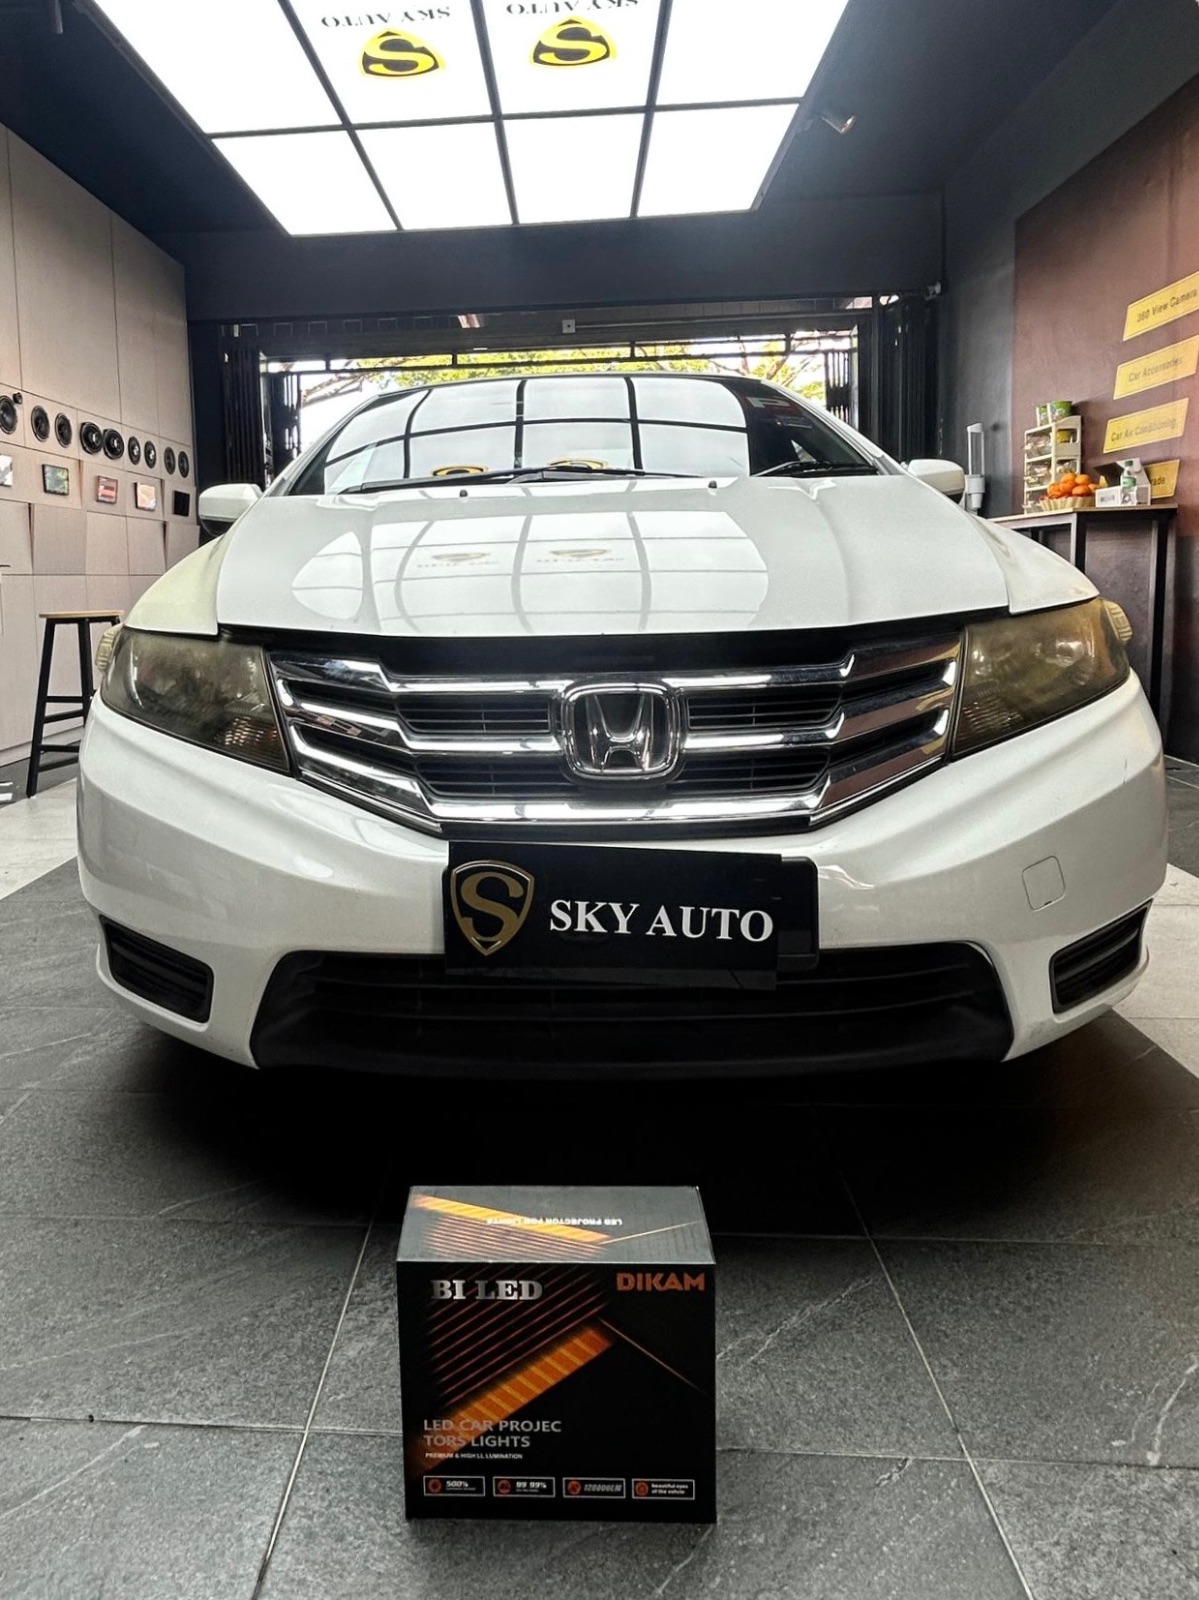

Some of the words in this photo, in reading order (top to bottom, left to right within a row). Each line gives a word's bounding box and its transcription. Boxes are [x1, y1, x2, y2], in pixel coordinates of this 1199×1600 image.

[1152, 303, 1168, 315] View
[1169, 289, 1198, 307] Camera
[1128, 372, 1140, 382] Car
[1142, 357, 1183, 377] Accessories
[1111, 432, 1123, 442] Car
[549, 899, 640, 934] SKY
[646, 906, 774, 942] AUTO
[430, 1279, 466, 1300] BI
[475, 1279, 543, 1300] LED
[616, 1272, 705, 1292] DIKAM
[423, 1419, 453, 1431] LED
[460, 1420, 494, 1432] CAR
[499, 1420, 562, 1433] PROJEC
[423, 1435, 467, 1447] TORS
[471, 1435, 531, 1448] LIGHTS
